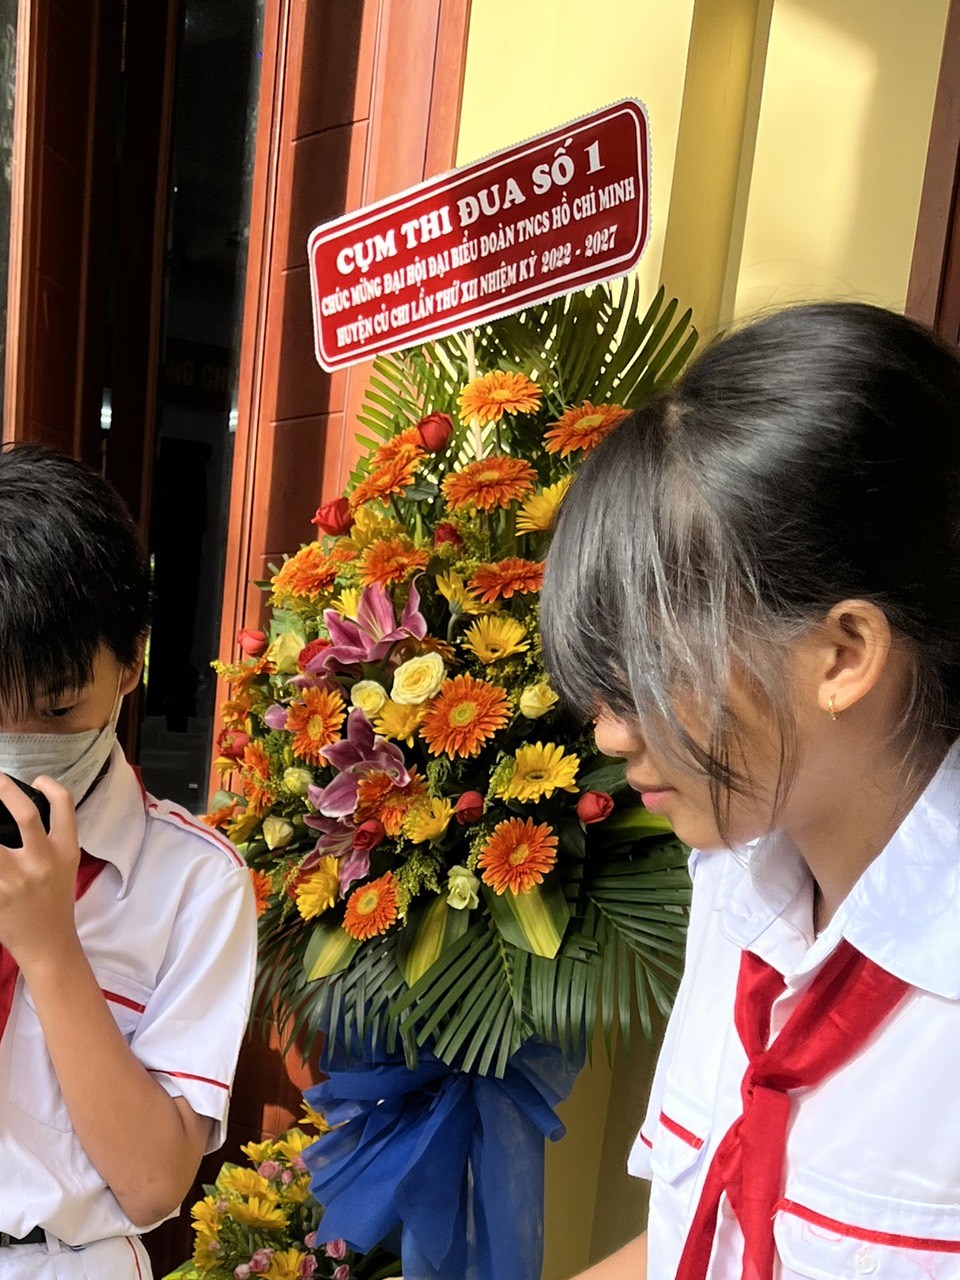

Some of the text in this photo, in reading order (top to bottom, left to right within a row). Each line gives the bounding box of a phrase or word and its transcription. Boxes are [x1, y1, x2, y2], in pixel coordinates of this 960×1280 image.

[321, 176, 635, 317] CHÚC MỪNG ĐẠI HỘI ĐẠI BIỂU ĐOÀN TNCS HỒ CHÍ MINH
[336, 137, 605, 275] CỤM THI ĐUA SỐ 1
[337, 224, 618, 348] HUYỆN CỦ CHI LẦN THỨ XII NHIỆM KỲ 2022 - 2027
